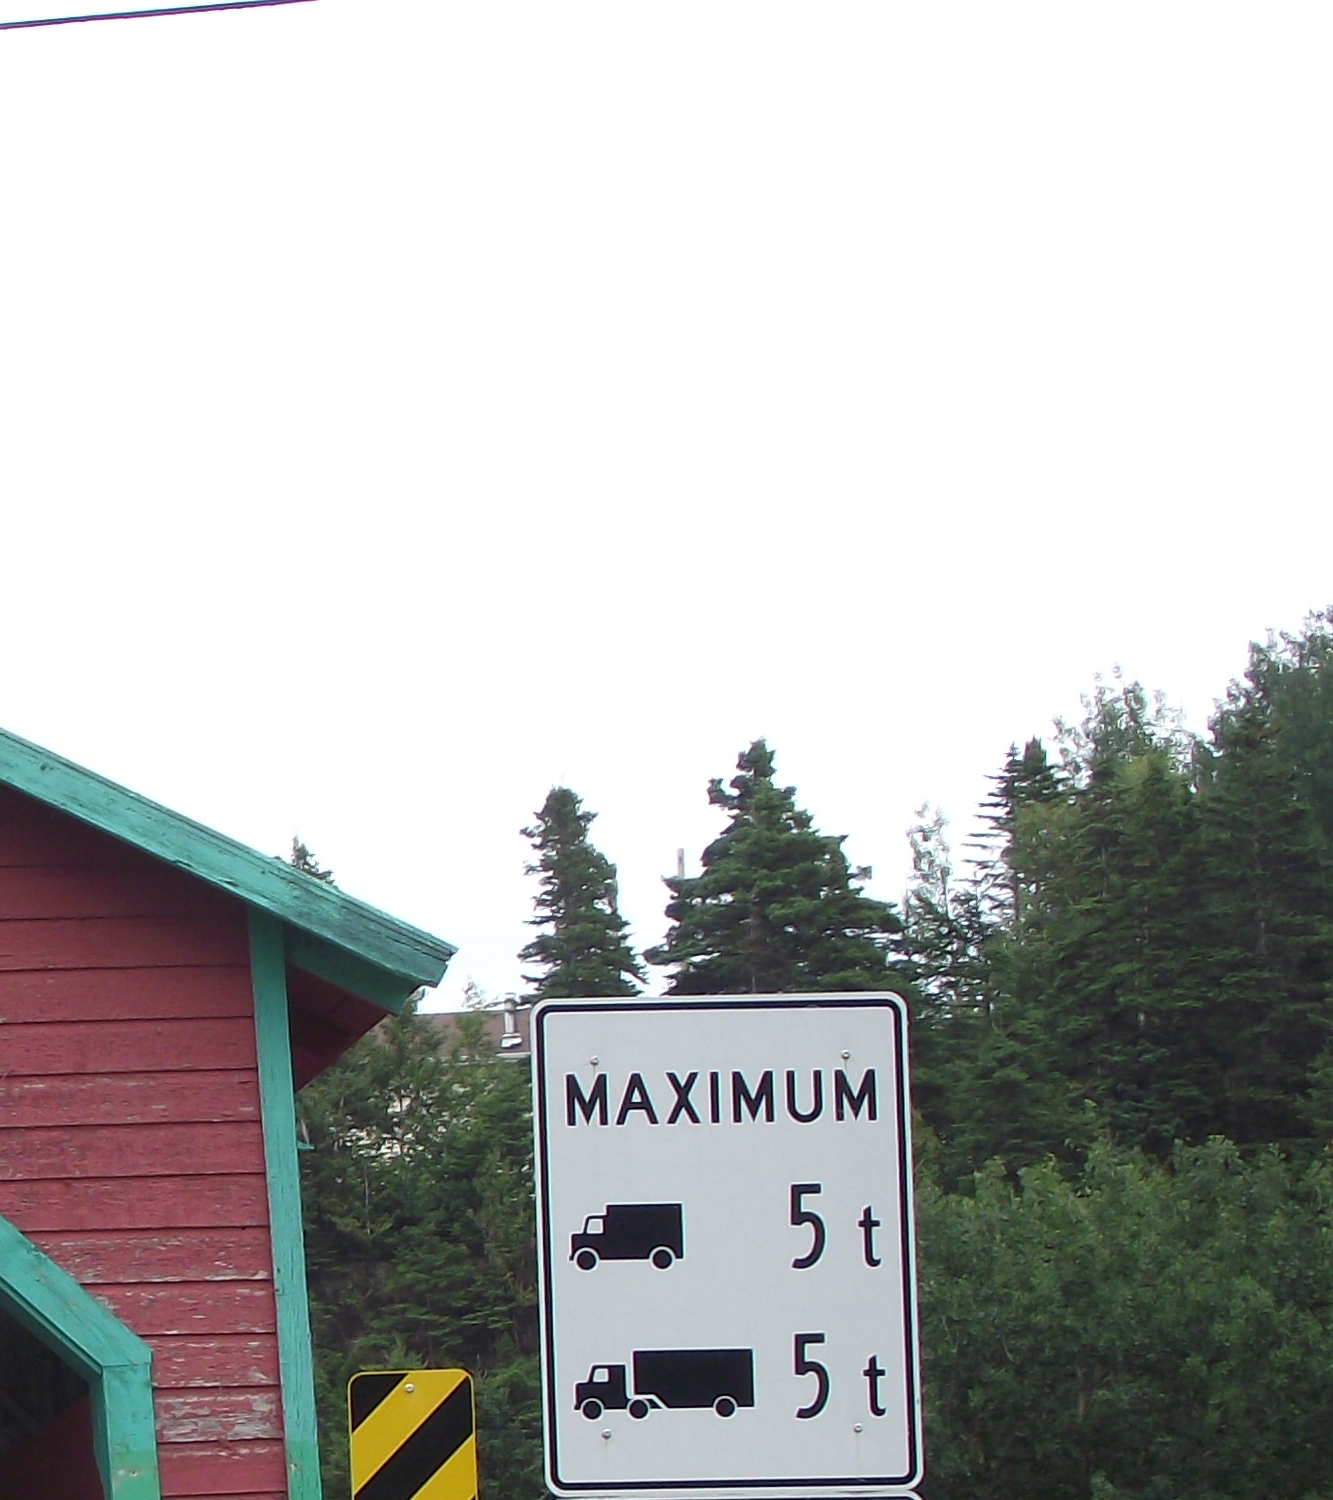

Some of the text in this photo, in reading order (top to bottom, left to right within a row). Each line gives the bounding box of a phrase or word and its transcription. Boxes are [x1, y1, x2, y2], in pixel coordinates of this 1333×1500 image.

[565, 1068, 878, 1126] MAXIMUM
[789, 1182, 882, 1270] 5 t
[793, 1332, 887, 1419] 5 t
